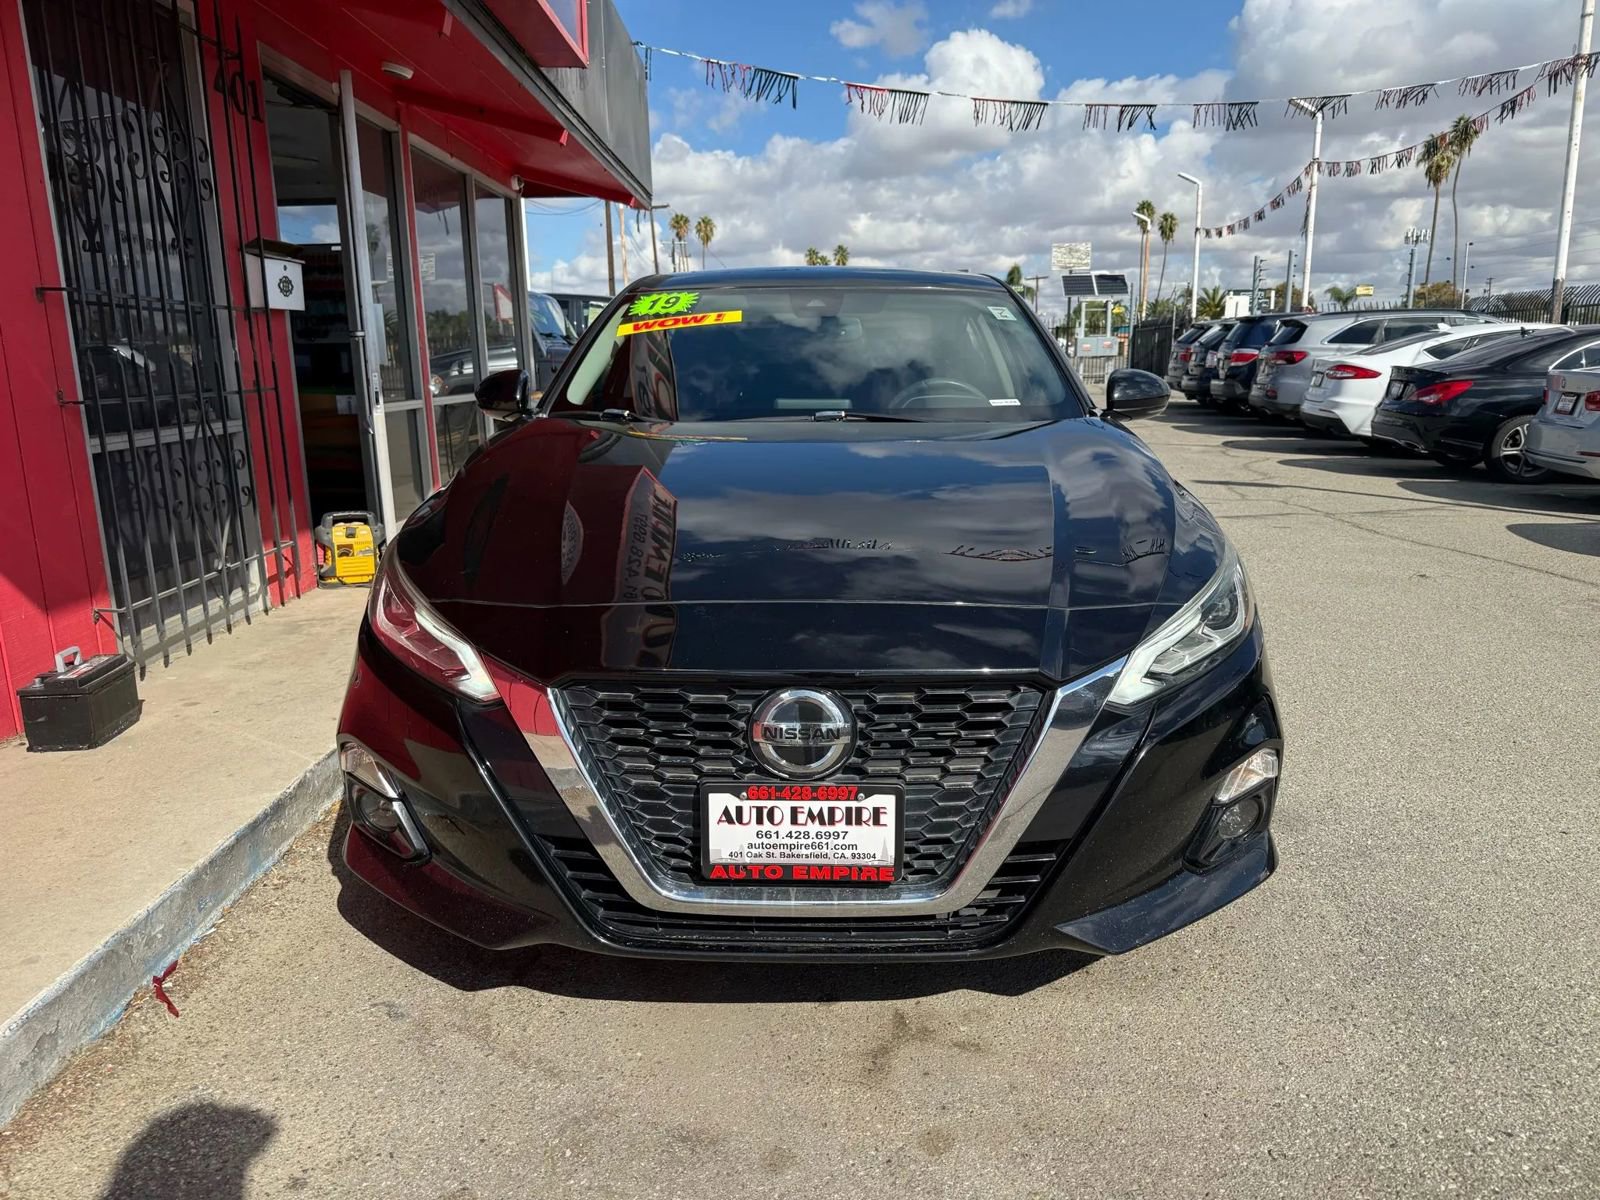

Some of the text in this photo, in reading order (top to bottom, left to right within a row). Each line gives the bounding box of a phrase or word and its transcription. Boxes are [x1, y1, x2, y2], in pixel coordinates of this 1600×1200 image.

[213, 65, 265, 123] 401
[648, 296, 681, 310] 19
[633, 314, 710, 331] WOW
[762, 726, 842, 741] NISSAN
[747, 785, 858, 800] 661-428-6997
[717, 804, 888, 828] AUTO EMPIRE
[756, 830, 849, 840] 661.428.6997
[747, 841, 858, 852] autoempire661.com
[746, 851, 764, 859] Oak
[765, 851, 777, 859] St.
[779, 851, 831, 860] Bakersfield,
[832, 852, 849, 860] CA.
[851, 852, 877, 860] 93304
[709, 864, 896, 881] AUTO EMPIRE
